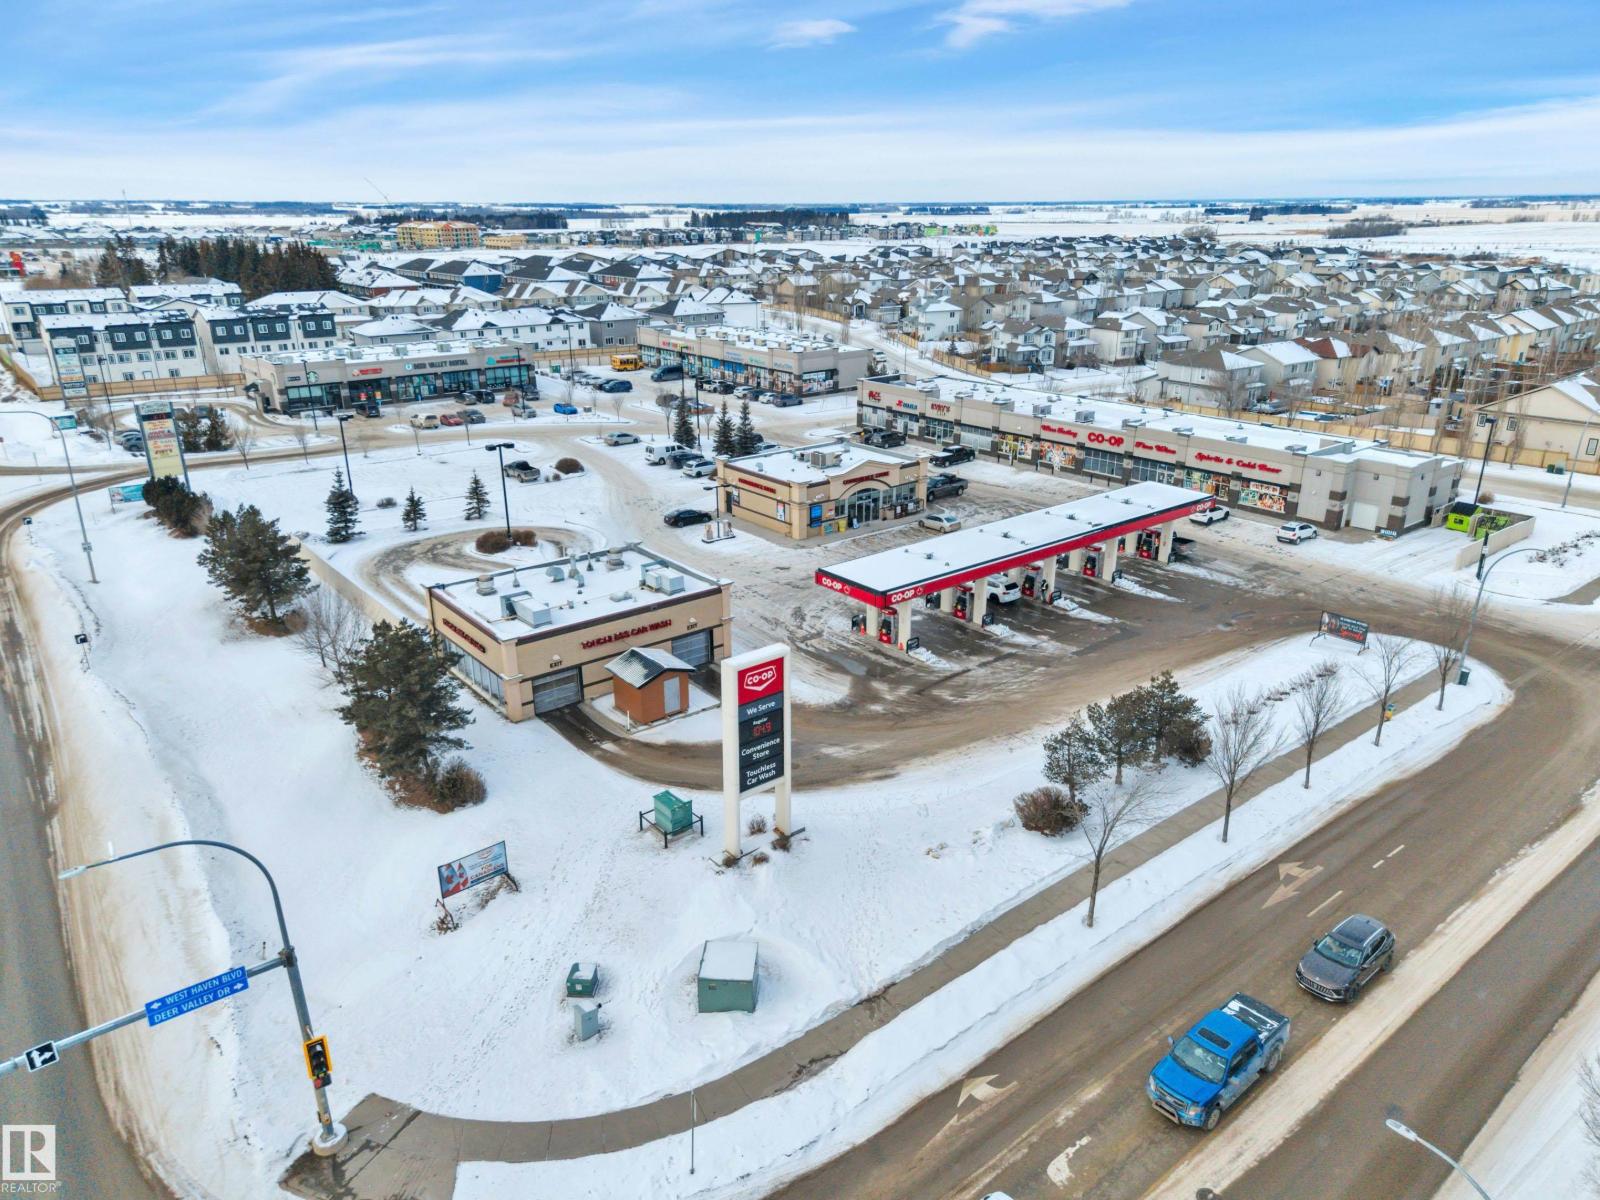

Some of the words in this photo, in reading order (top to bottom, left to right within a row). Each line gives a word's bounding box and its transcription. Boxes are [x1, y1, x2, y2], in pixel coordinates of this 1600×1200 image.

[1087, 432, 1124, 447] CO-OP
[822, 577, 843, 590] CO-OP
[892, 590, 915, 602] CO-OP
[747, 670, 774, 685] CO-OP
[746, 708, 757, 716] We
[758, 701, 776, 712] Serve
[741, 738, 780, 756] Convenience
[752, 749, 770, 760] Store
[746, 762, 776, 778] Touchless
[746, 776, 758, 785] Car
[759, 769, 776, 780] Wash
[165, 990, 188, 1005] WEST
[191, 978, 219, 995] HAVEN
[222, 969, 242, 983] BLVD
[154, 1007, 179, 1023] DEER
[181, 992, 214, 1011] VALLEY
[217, 987, 231, 998] DR
